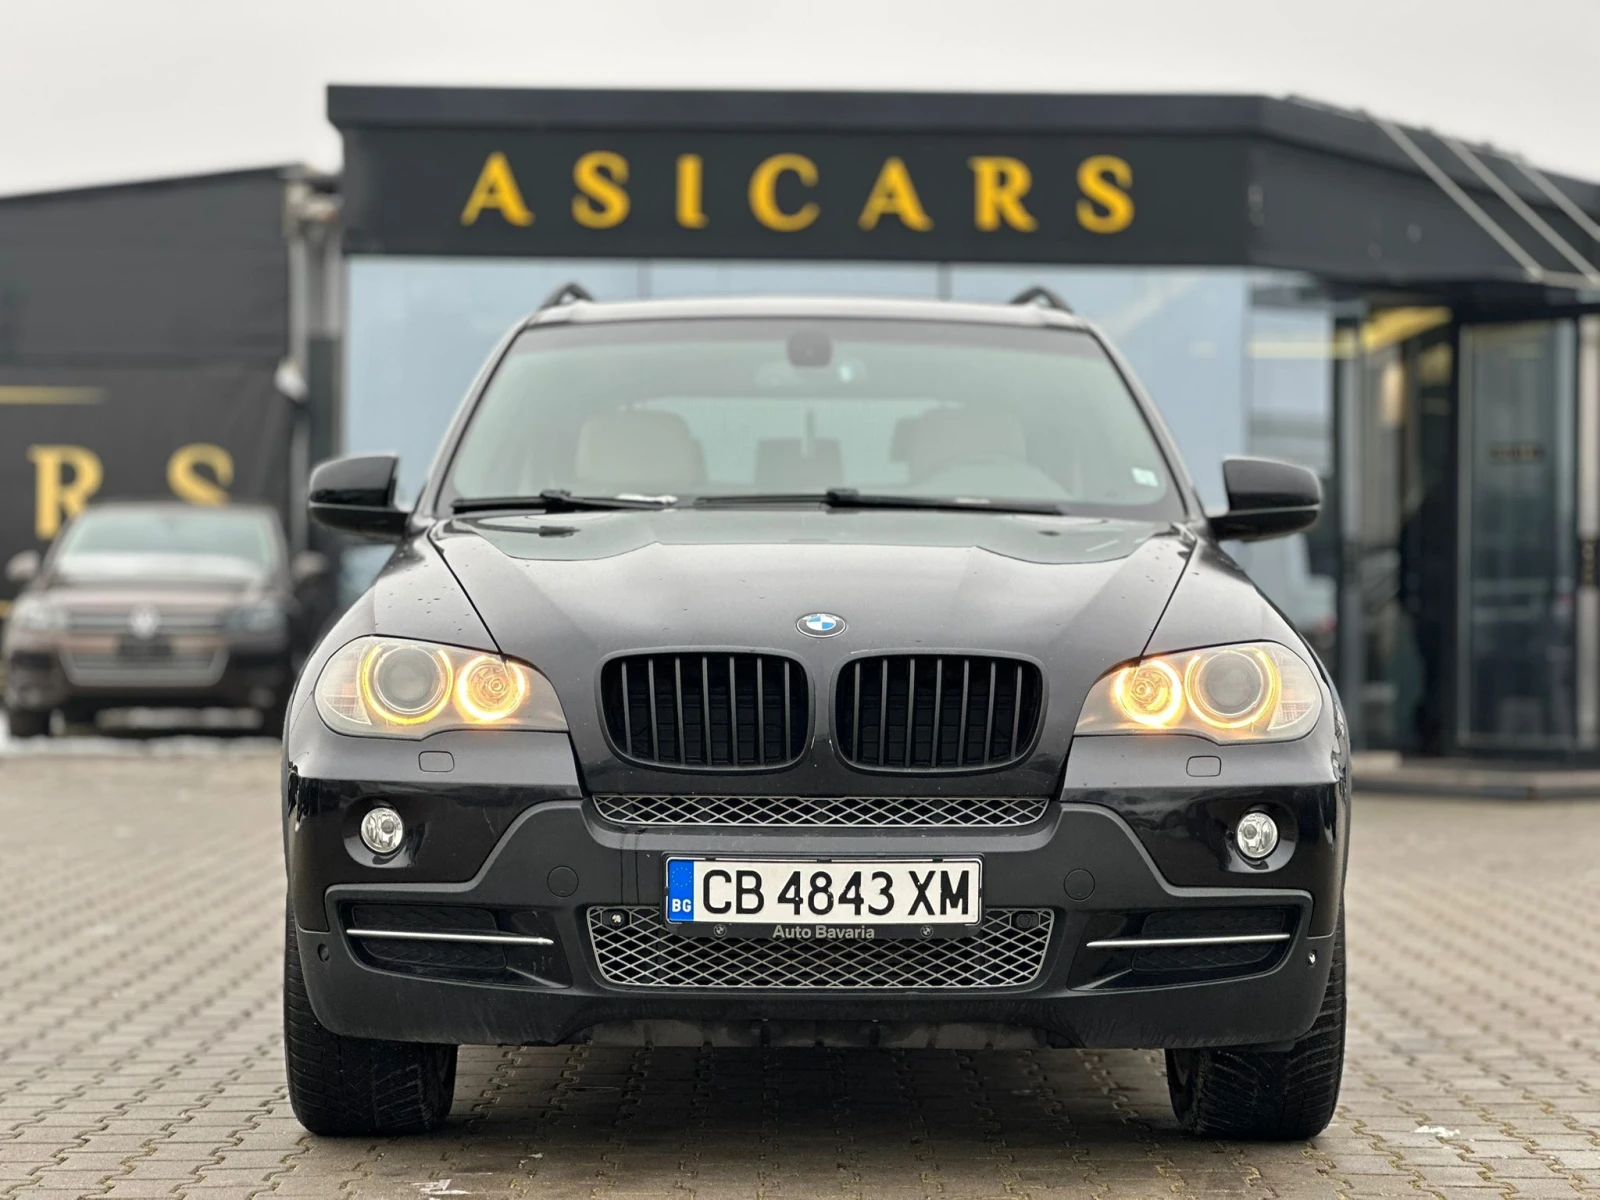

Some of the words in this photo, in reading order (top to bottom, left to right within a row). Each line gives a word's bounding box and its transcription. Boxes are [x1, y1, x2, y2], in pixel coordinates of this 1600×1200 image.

[460, 150, 1135, 234] ASICARS
[671, 898, 692, 913] BG
[702, 869, 765, 915] CB
[777, 870, 895, 916] 4843
[907, 870, 970, 916] XM
[772, 924, 812, 939] Auto
[815, 924, 875, 939] Bavaria
